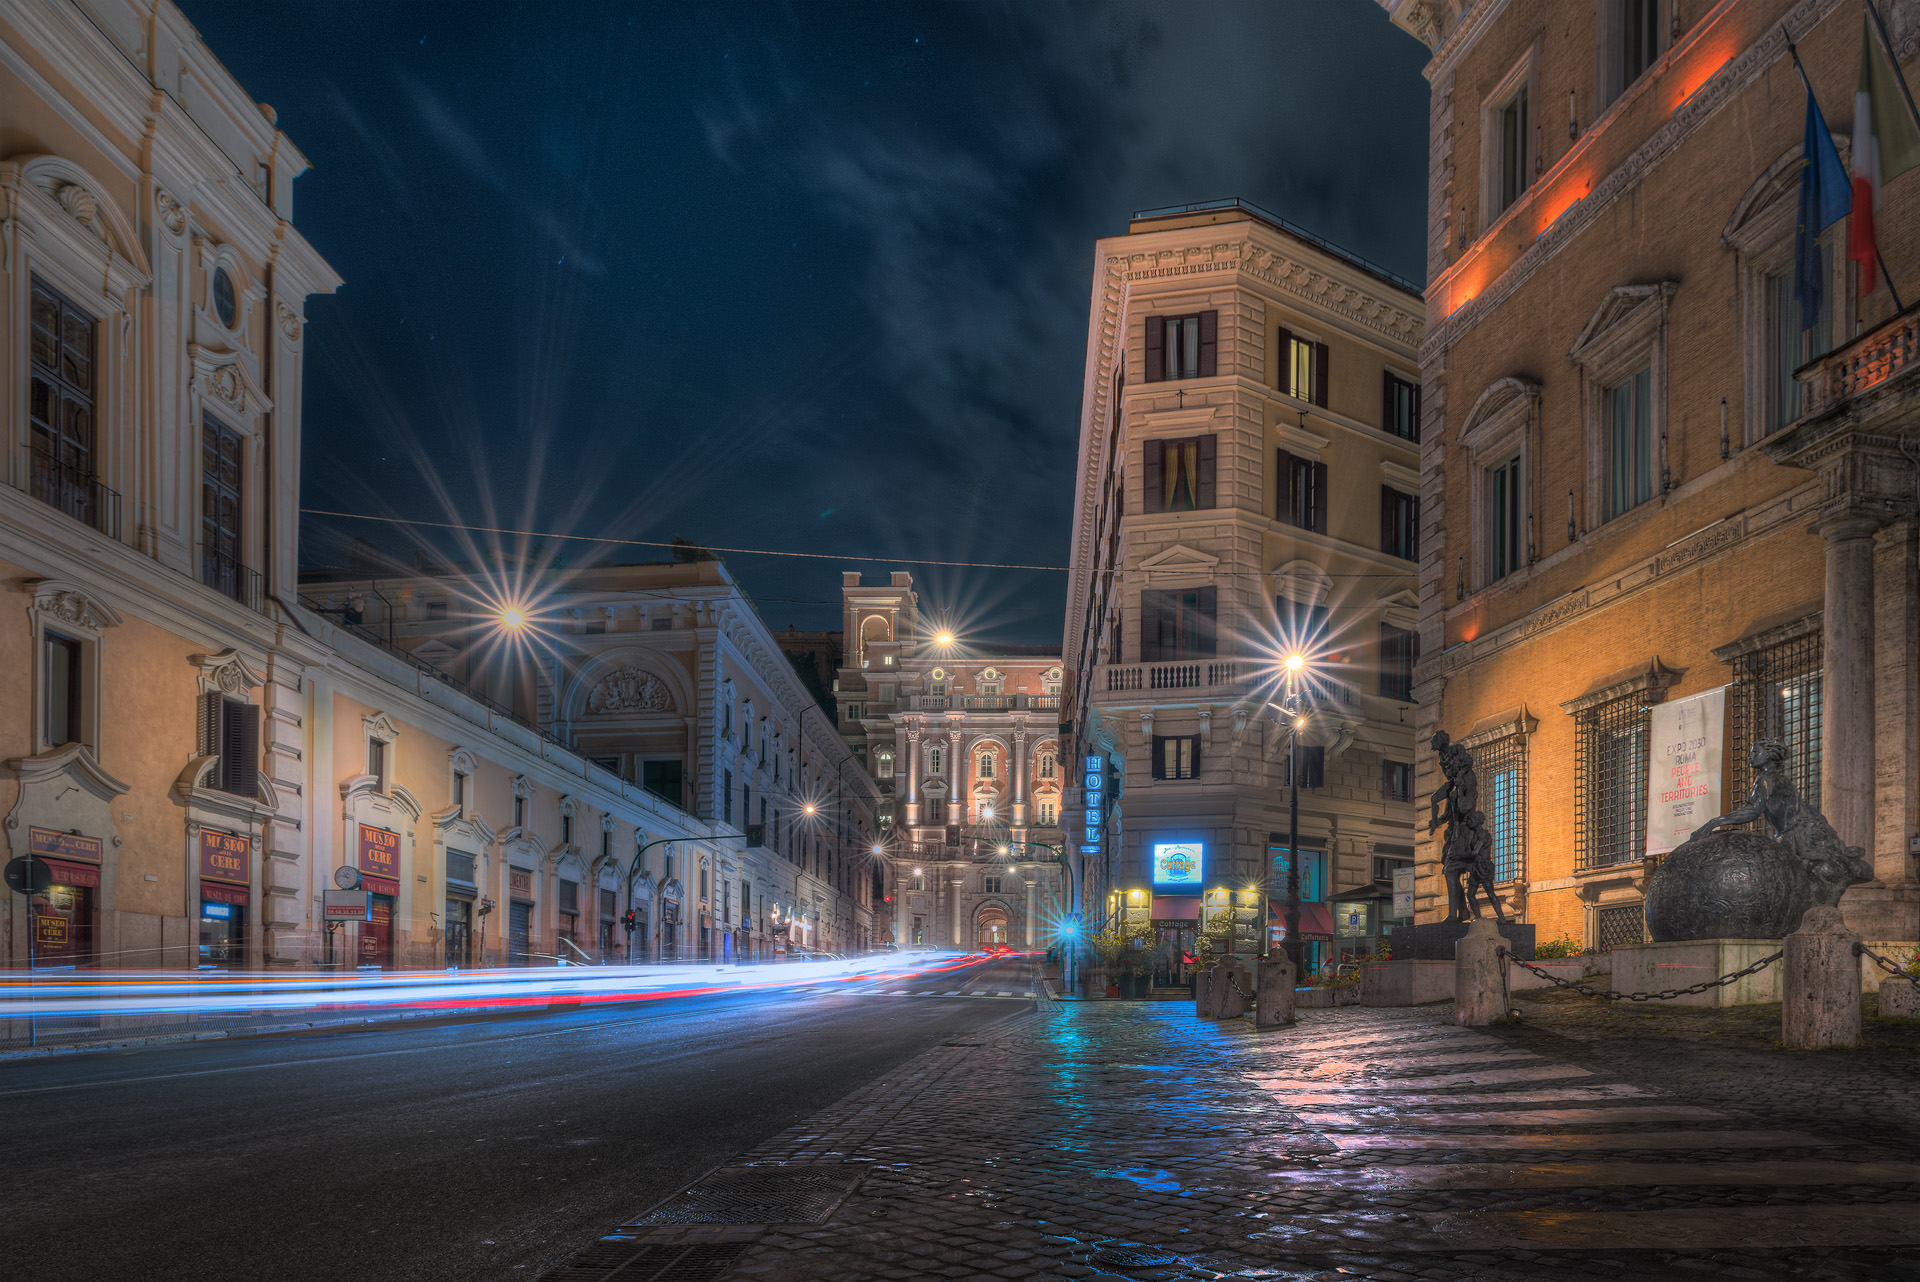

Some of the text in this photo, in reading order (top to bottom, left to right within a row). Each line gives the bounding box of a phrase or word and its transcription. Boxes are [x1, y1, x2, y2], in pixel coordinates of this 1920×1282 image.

[1667, 736, 1706, 757] EXPO 2030
[1675, 751, 1697, 766] ROMA
[1671, 761, 1700, 779] PEOPLE
[1676, 775, 1693, 789] AND
[1087, 757, 1101, 842] HOTEL
[1661, 783, 1709, 804] TERRITORIES
[206, 834, 245, 853] MUSEO
[365, 829, 395, 848] MUSEO
[210, 854, 241, 871] CERE
[368, 849, 392, 865] CERE
[1160, 858, 1197, 872] Cottage
[40, 919, 65, 927] MUSEO
[43, 928, 63, 937] CERE
